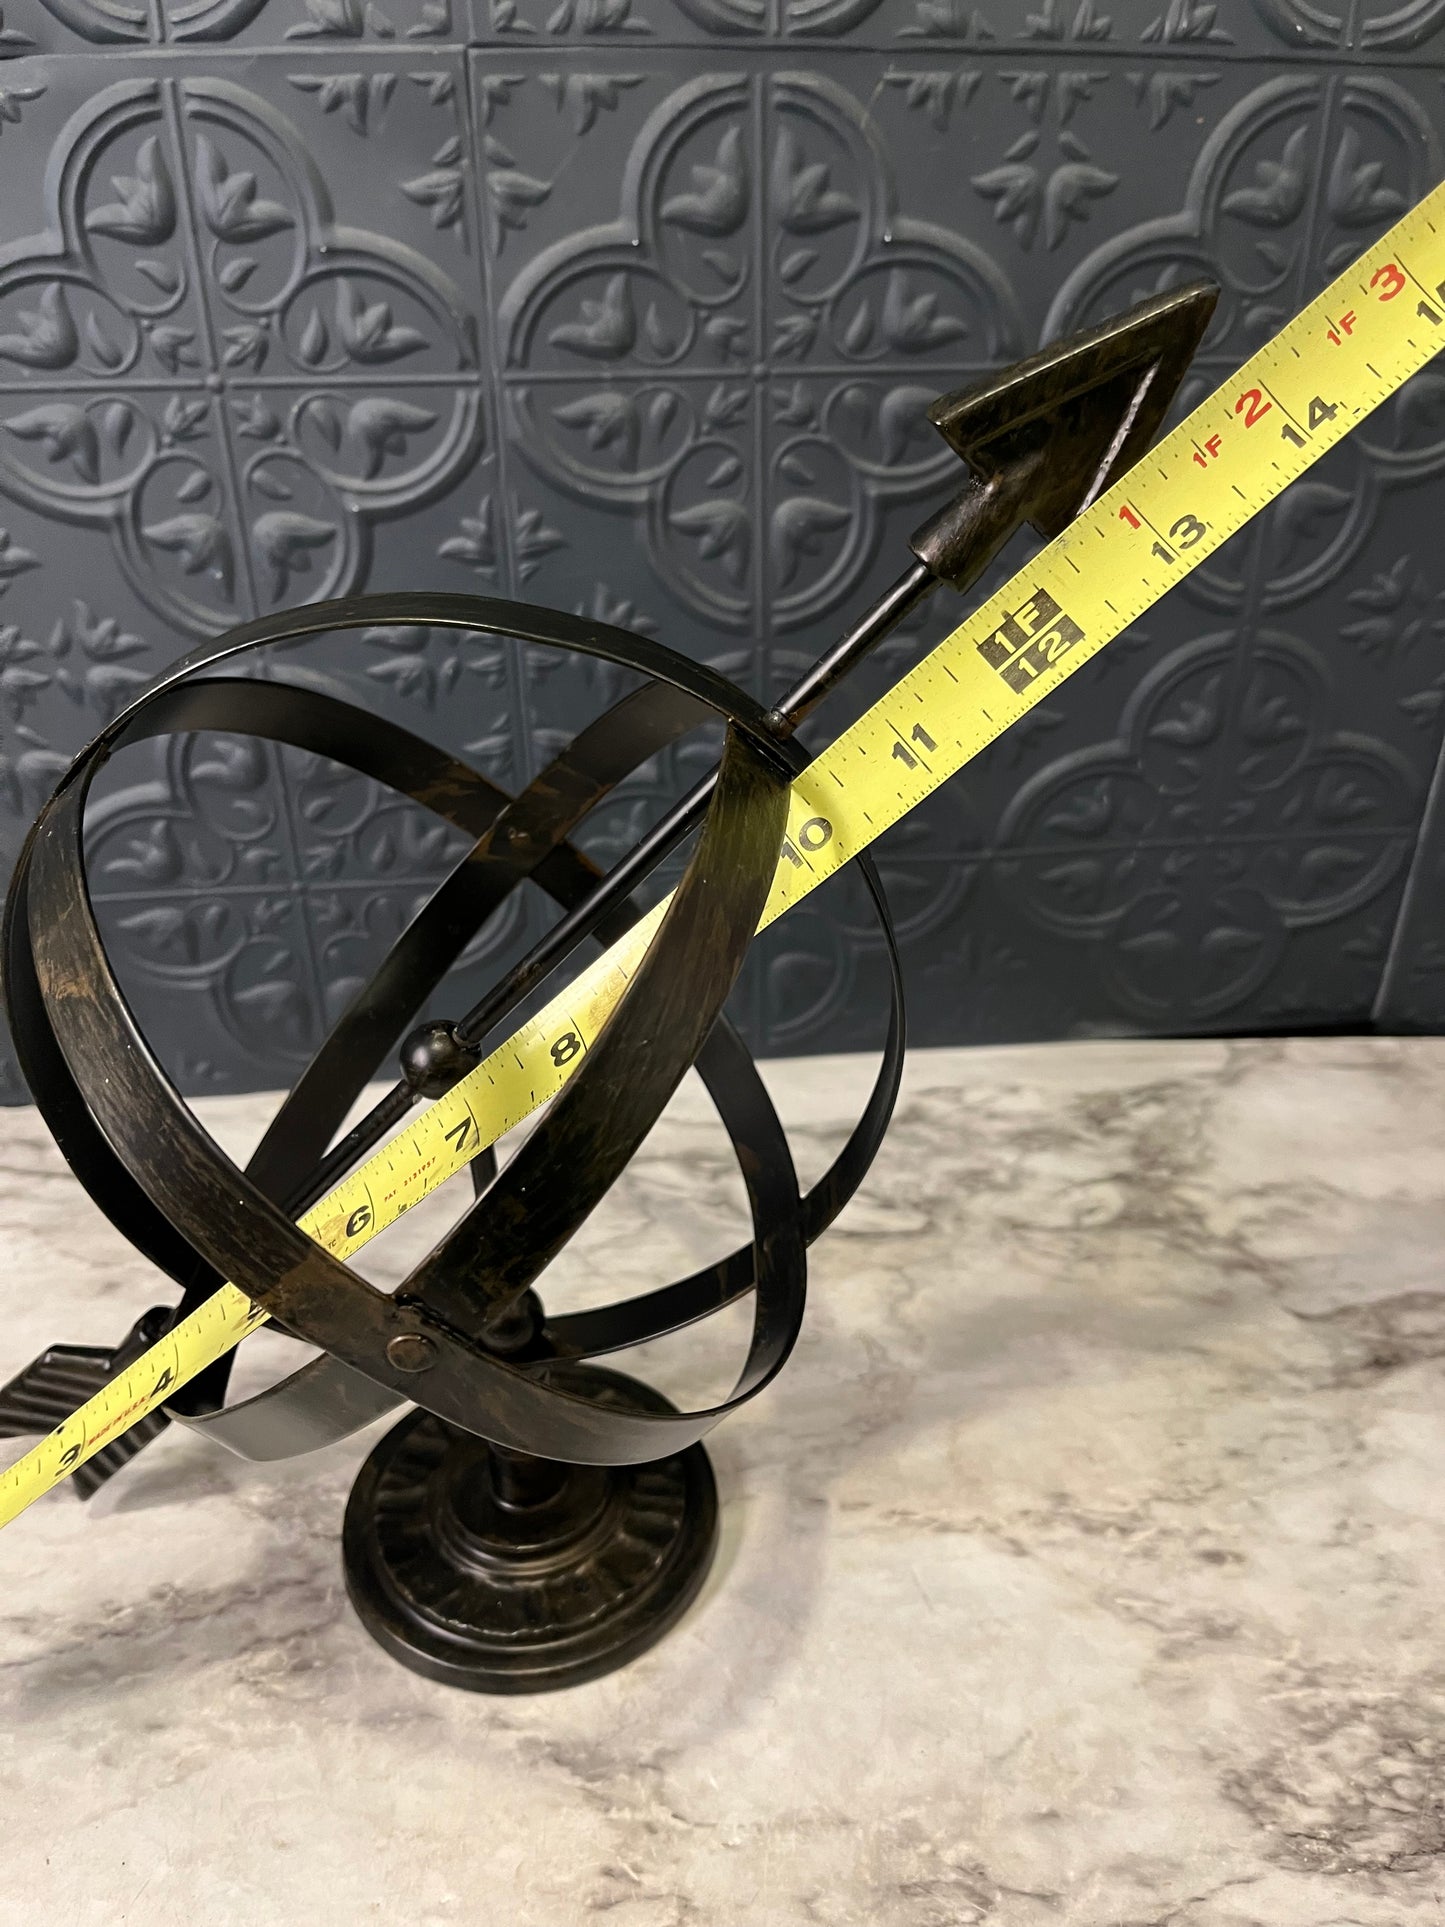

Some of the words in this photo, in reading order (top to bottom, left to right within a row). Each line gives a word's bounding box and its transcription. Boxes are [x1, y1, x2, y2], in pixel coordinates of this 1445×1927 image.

[1327, 310, 1357, 346] 1F
[1370, 263, 1406, 302] 3
[1416, 280, 1445, 326] 1
[1193, 434, 1222, 468] 1F
[1235, 388, 1273, 428] 2
[1280, 396, 1338, 448] 14
[1119, 505, 1141, 530] 1
[1151, 514, 1207, 565] 13
[994, 601, 1040, 654] 1F
[1018, 630, 1071, 678] 12
[892, 722, 938, 770] 11
[780, 817, 833, 869] 10
[549, 1032, 581, 1067] 8
[444, 1116, 472, 1153] 7
[346, 1205, 372, 1238] 6
[150, 1366, 174, 1398] 4
[55, 1443, 82, 1477] 3
